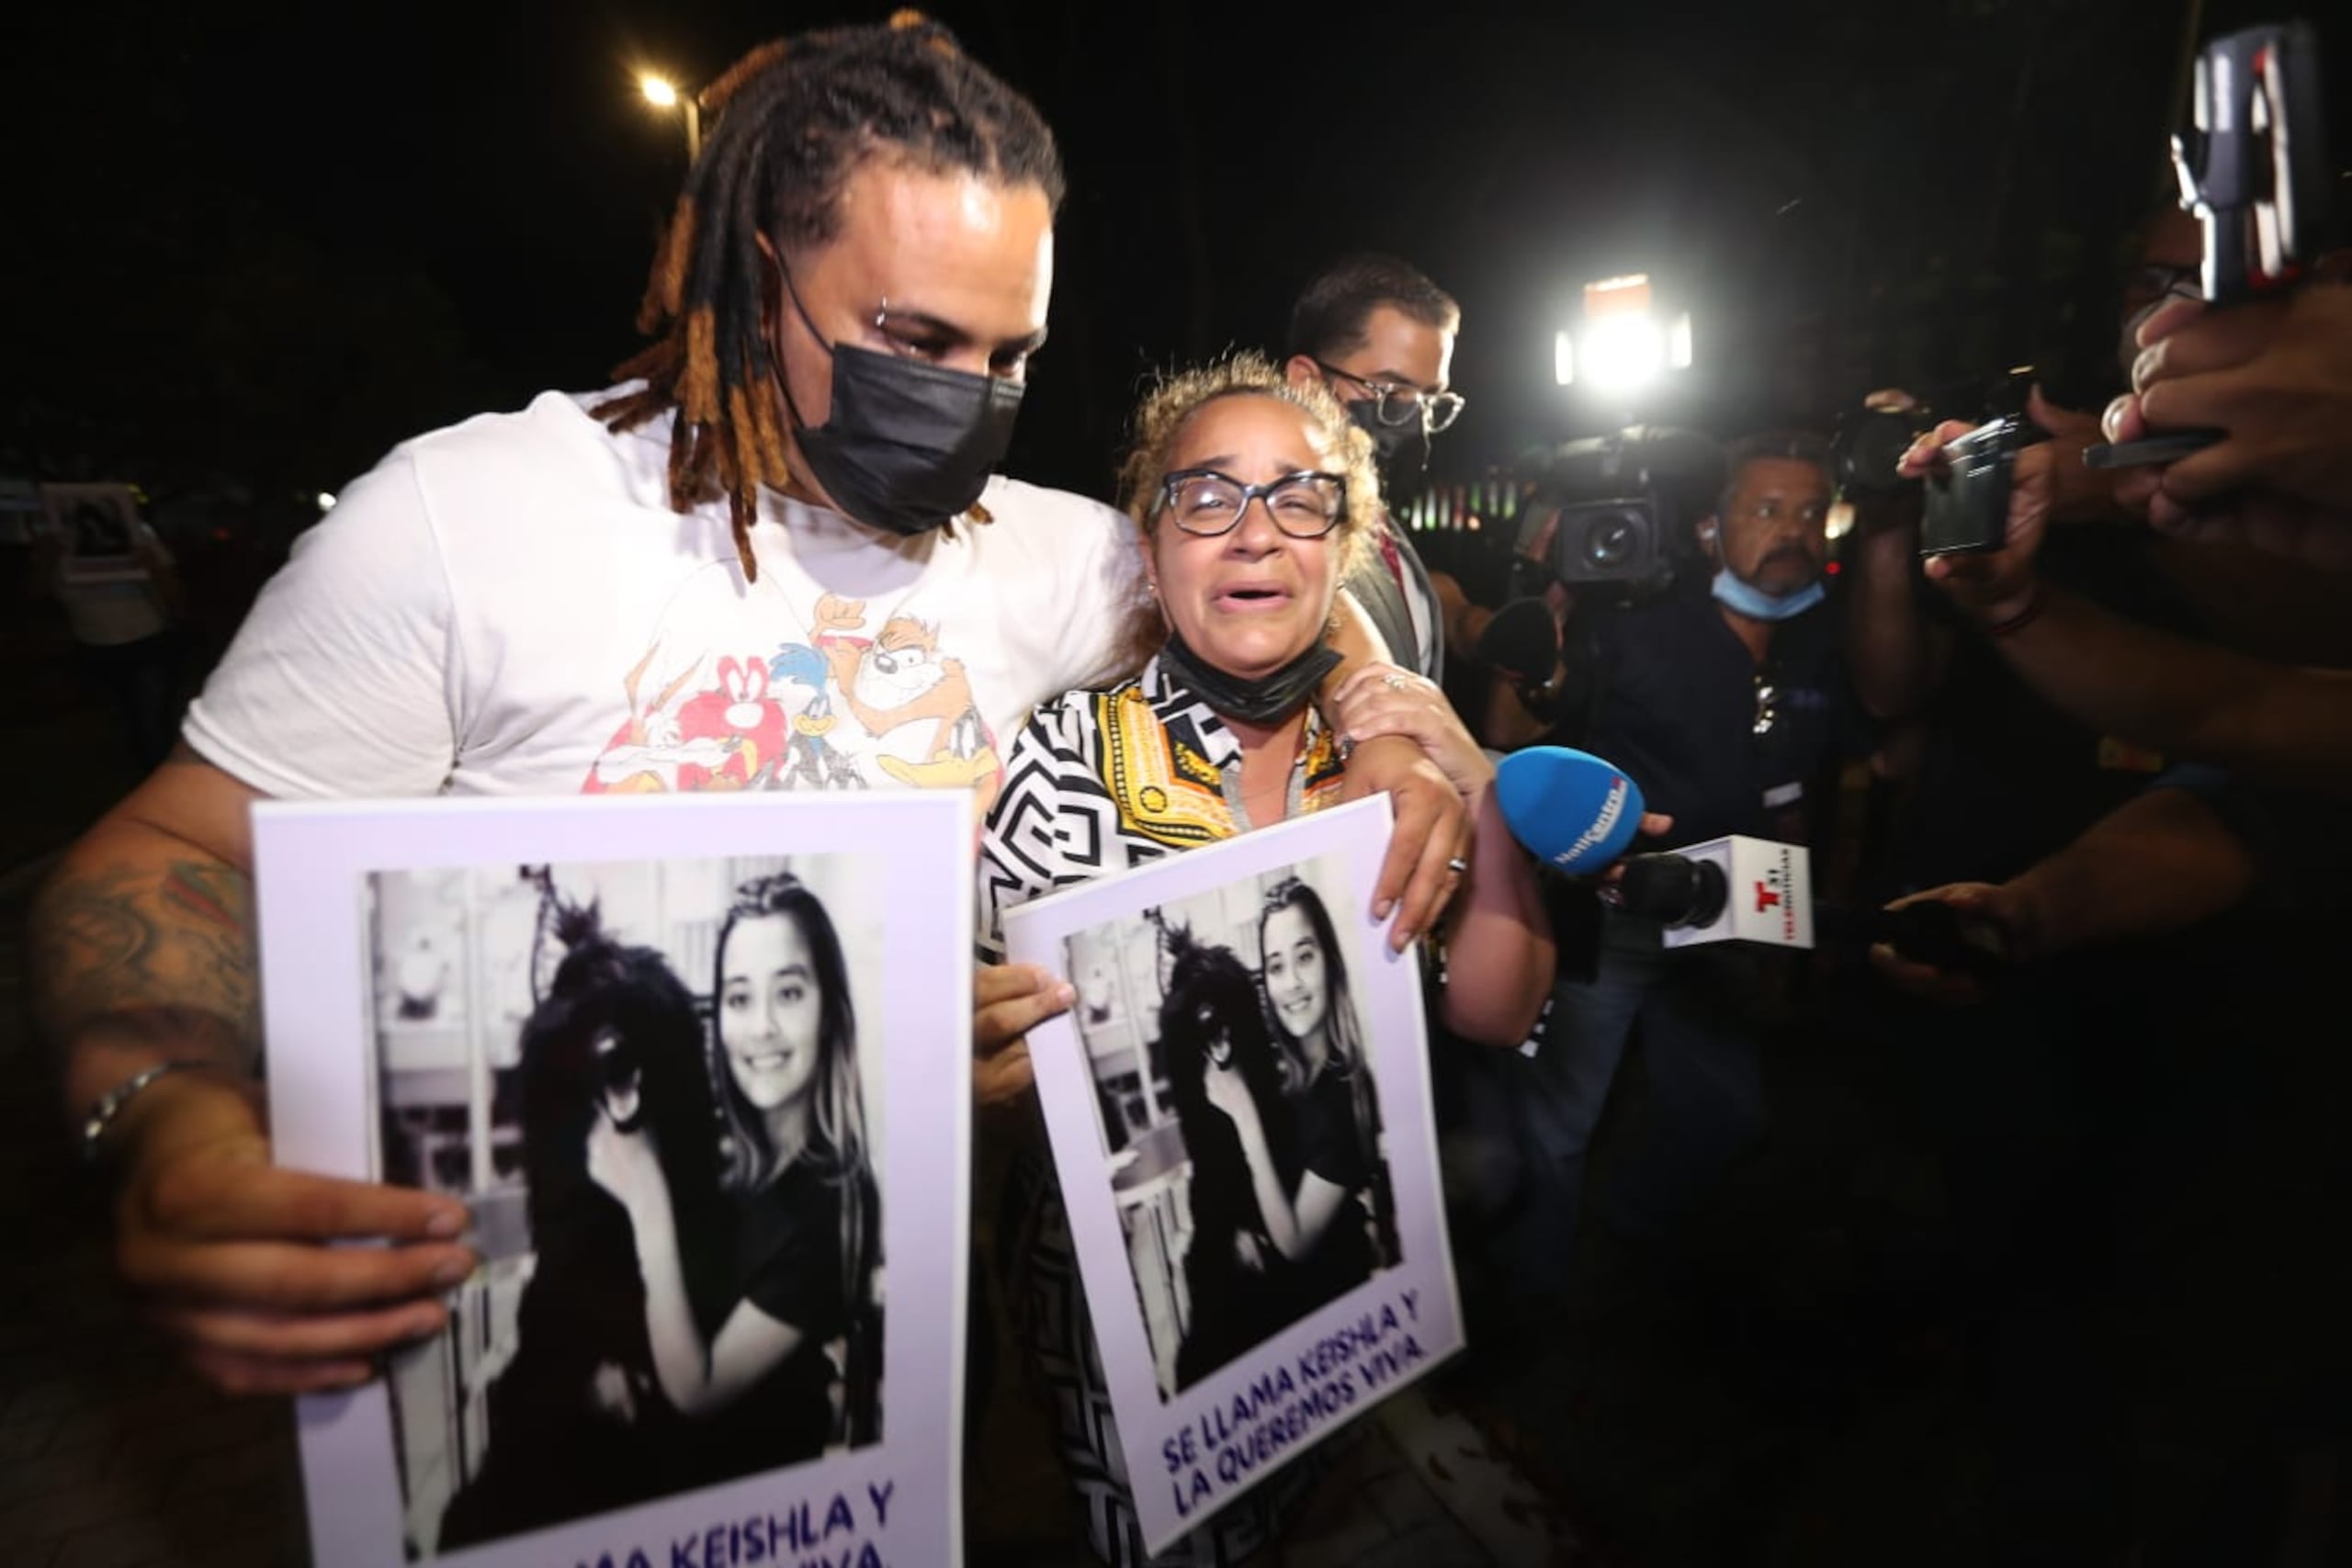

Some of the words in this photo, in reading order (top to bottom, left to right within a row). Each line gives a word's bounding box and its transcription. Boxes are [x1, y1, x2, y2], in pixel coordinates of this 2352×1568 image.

[1162, 1425, 1195, 1475] SE
[1201, 1365, 1295, 1450] LLAMA
[1297, 1303, 1399, 1384] KEISHLA
[1400, 1288, 1419, 1322] Y
[1172, 1468, 1213, 1518] LA
[1216, 1371, 1357, 1485] QUEREMOS
[671, 1491, 854, 1568] KEISHLA
[868, 1478, 894, 1527] Y
